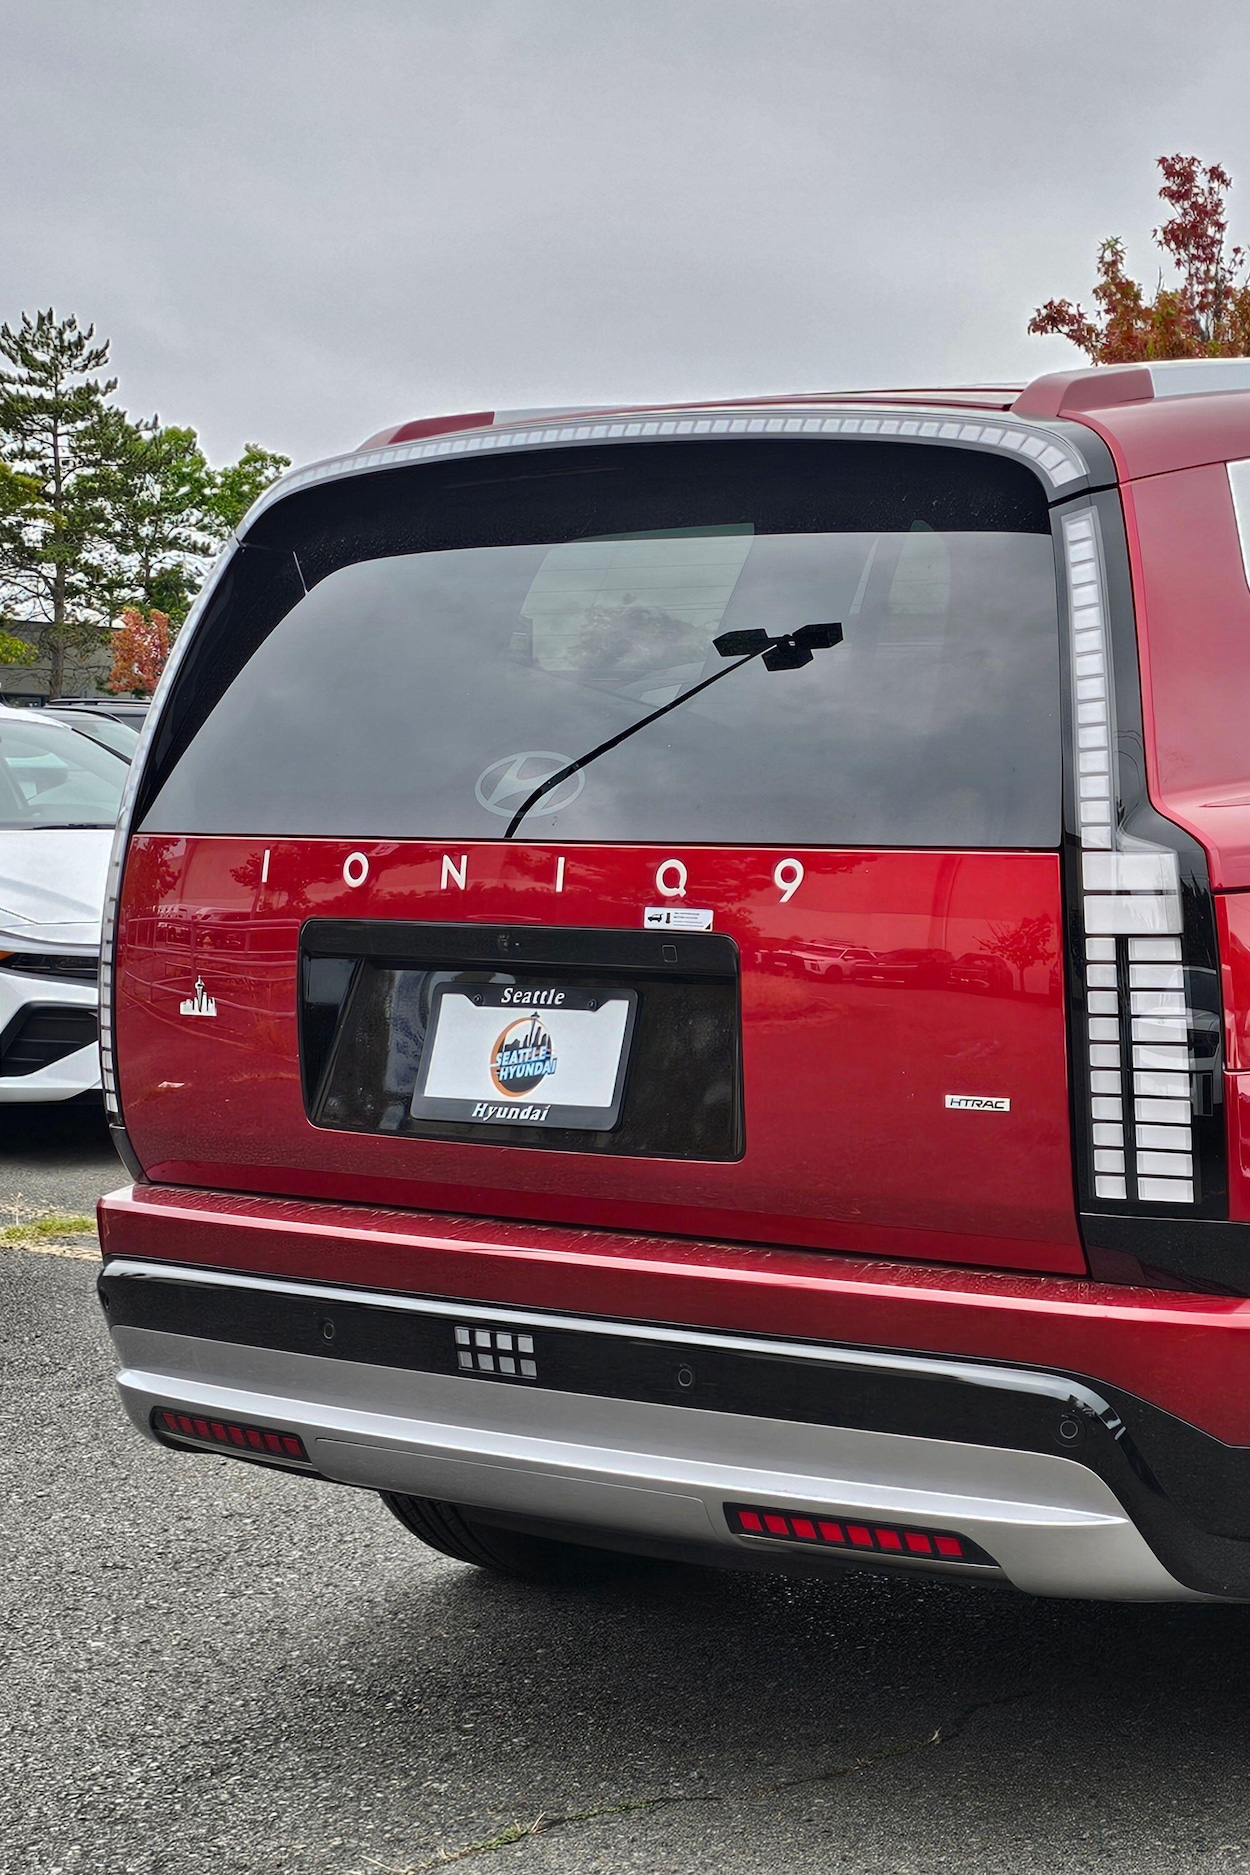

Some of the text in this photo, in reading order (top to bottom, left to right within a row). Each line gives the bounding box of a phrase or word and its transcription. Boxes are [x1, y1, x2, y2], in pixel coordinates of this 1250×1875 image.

[501, 987, 566, 1006] Seattle
[496, 1044, 549, 1068] SEATTLE
[499, 1058, 557, 1081] HYUNDAI
[472, 1102, 551, 1122] Hyundai
[950, 1098, 1005, 1109] HTRAC
